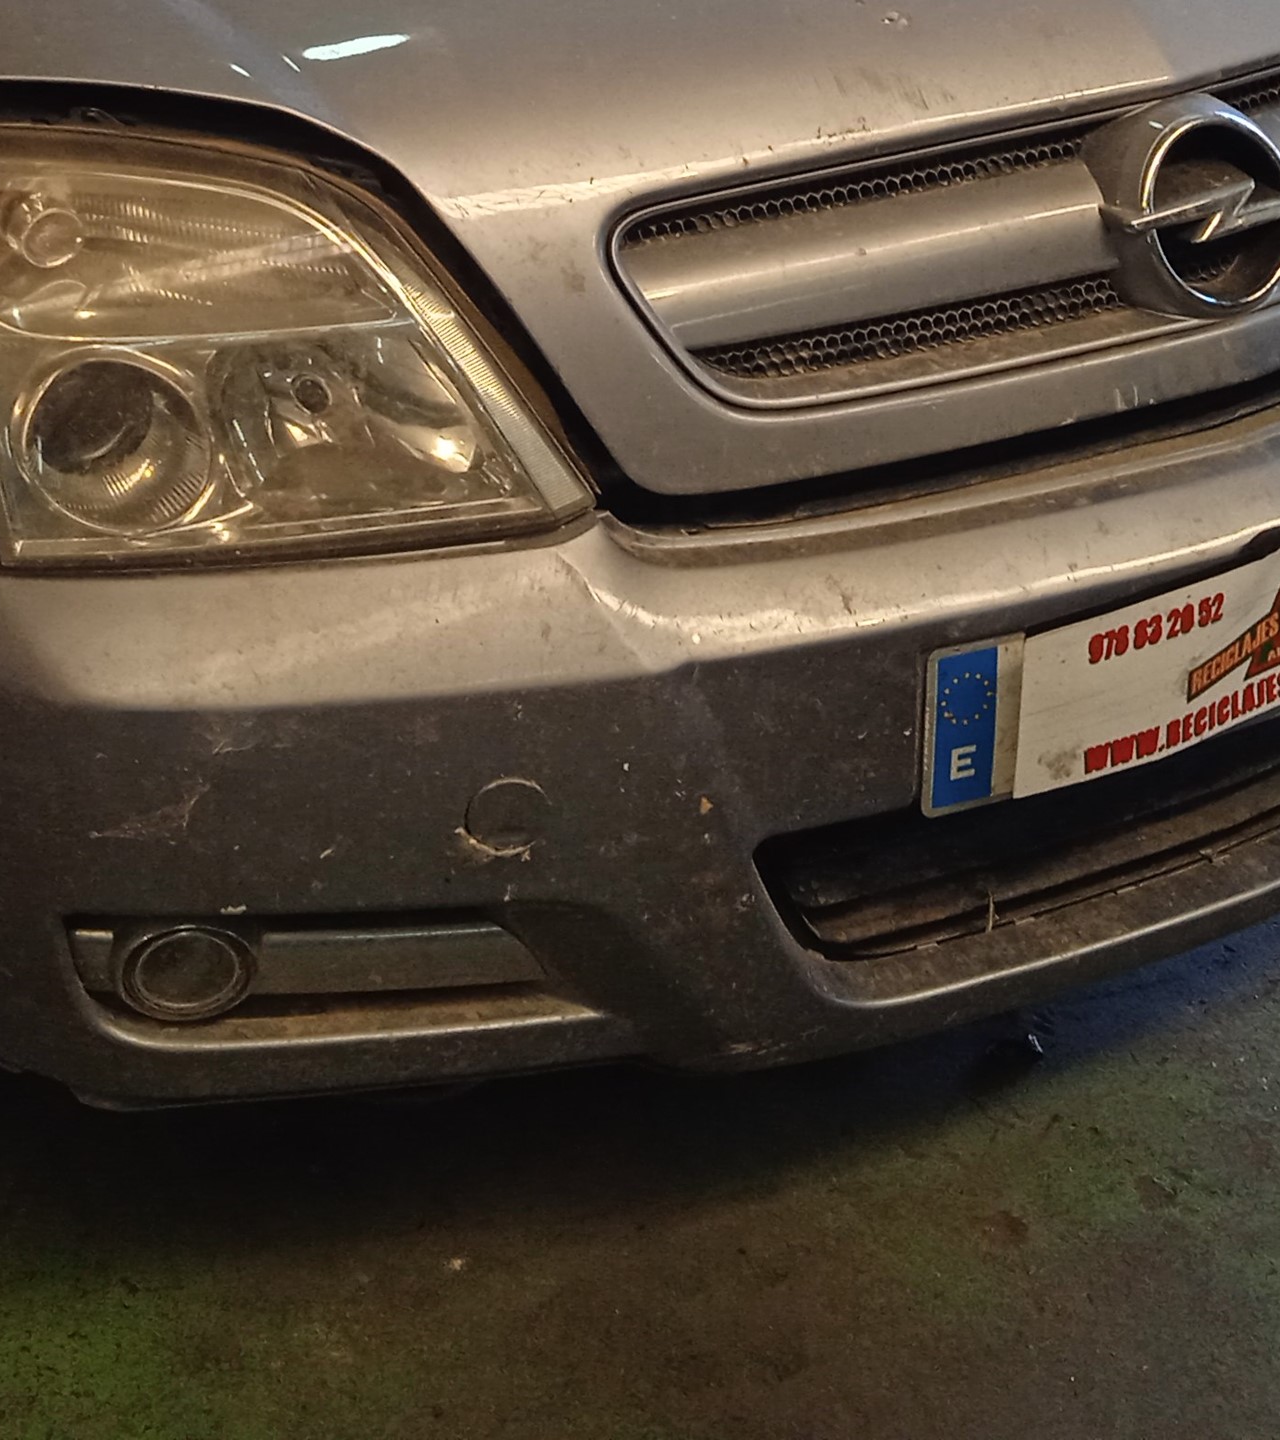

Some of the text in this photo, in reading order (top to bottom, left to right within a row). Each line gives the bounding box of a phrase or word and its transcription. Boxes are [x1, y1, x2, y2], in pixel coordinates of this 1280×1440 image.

[1166, 603, 1195, 640] 20
[1198, 592, 1225, 628] 52
[1190, 610, 1280, 695] RECICLAJES
[949, 744, 977, 781] E
